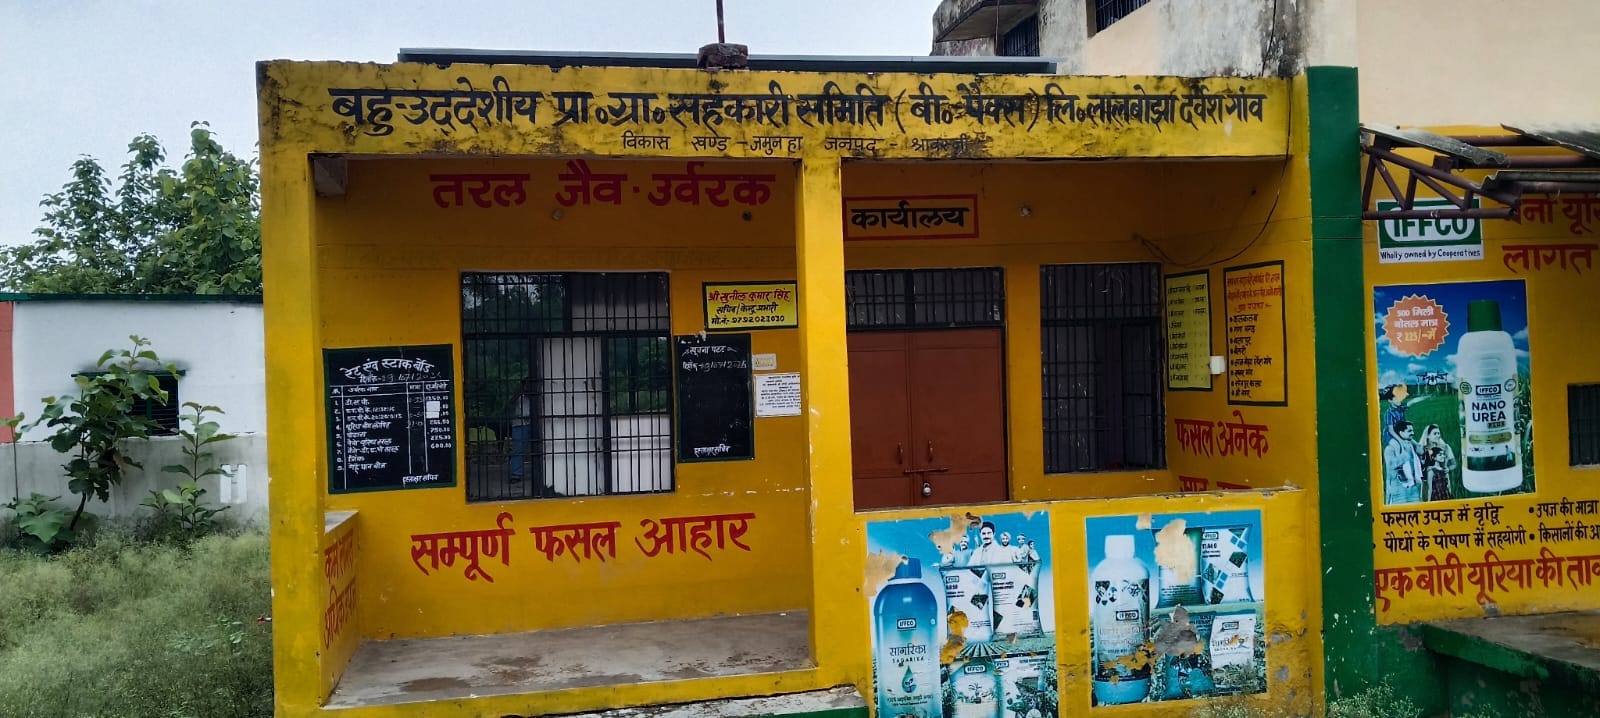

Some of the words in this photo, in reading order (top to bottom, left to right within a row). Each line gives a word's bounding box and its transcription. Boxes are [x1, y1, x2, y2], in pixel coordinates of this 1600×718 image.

[797, 81, 893, 131] समिति
[622, 130, 671, 151] विकास
[691, 136, 731, 151] खण्ड
[825, 136, 885, 151] जनपद
[429, 173, 530, 208] तरल
[555, 158, 628, 206] जैव
[647, 161, 775, 207] उर्वरक
[851, 200, 970, 230] कार्यालय
[1380, 251, 1402, 261] Wholly
[1404, 249, 1427, 259] owned
[1428, 249, 1437, 259] by
[1437, 248, 1481, 259] Cooperatives
[1502, 243, 1600, 276] लागत
[720, 289, 748, 304] सुनील
[749, 291, 772, 302] कुमार
[381, 358, 413, 370] स्टाक
[1480, 386, 1498, 394] IFFCO
[1471, 400, 1507, 412] NANO
[1472, 410, 1507, 423] UREA
[1174, 417, 1215, 459] फसल
[1216, 409, 1269, 459] अनेक
[1381, 510, 1421, 528] फसल
[1423, 508, 1455, 526] उपज
[1457, 503, 1471, 521] में
[1536, 502, 1559, 519] उपज
[1559, 497, 1574, 516] की
[1575, 499, 1600, 516] मात्रा
[411, 511, 514, 583] सम्पूर्ण
[529, 521, 621, 563] फसल
[634, 513, 756, 561] आहार
[1417, 530, 1430, 551] के
[1434, 527, 1470, 549] पोषण
[1473, 526, 1485, 547] में
[1487, 524, 1528, 550] सहयोगी
[1538, 521, 1574, 544] किसानों
[1574, 520, 1588, 540] की
[1375, 567, 1414, 613] एक
[1414, 551, 1467, 598] बोरी
[1466, 549, 1536, 606] यूरिया
[1535, 546, 1567, 589] की
[889, 643, 927, 657] सागरिका
